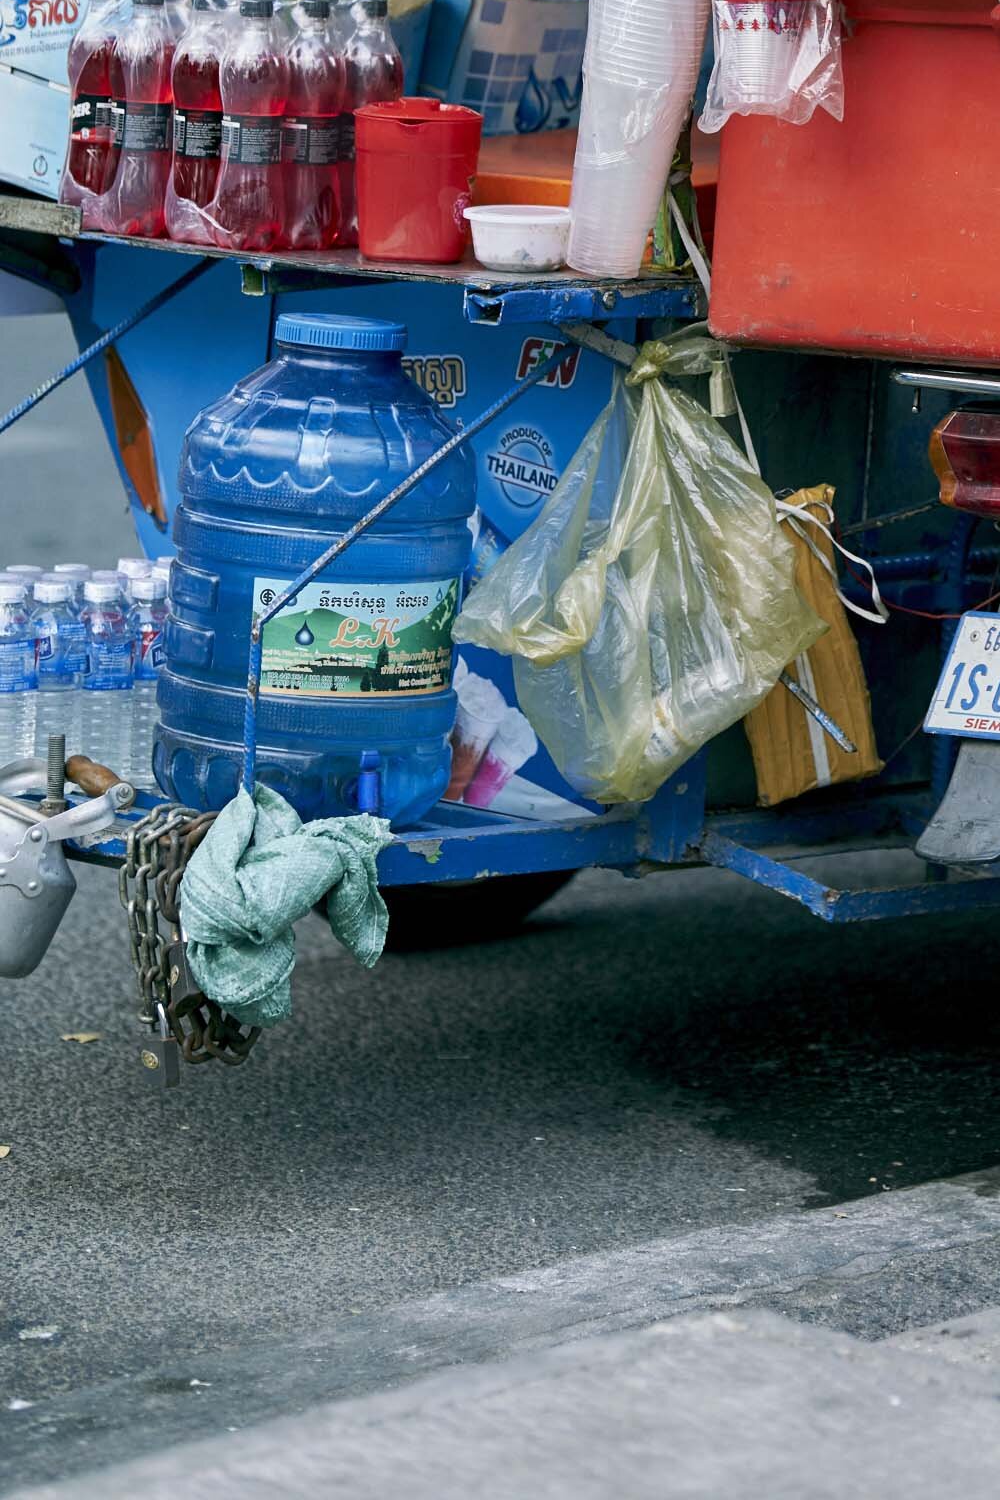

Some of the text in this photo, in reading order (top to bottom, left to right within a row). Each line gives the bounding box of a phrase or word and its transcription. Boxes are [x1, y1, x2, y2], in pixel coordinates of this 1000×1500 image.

[500, 427, 553, 457] PRODUCT OF
[487, 454, 559, 491] THAILAND
